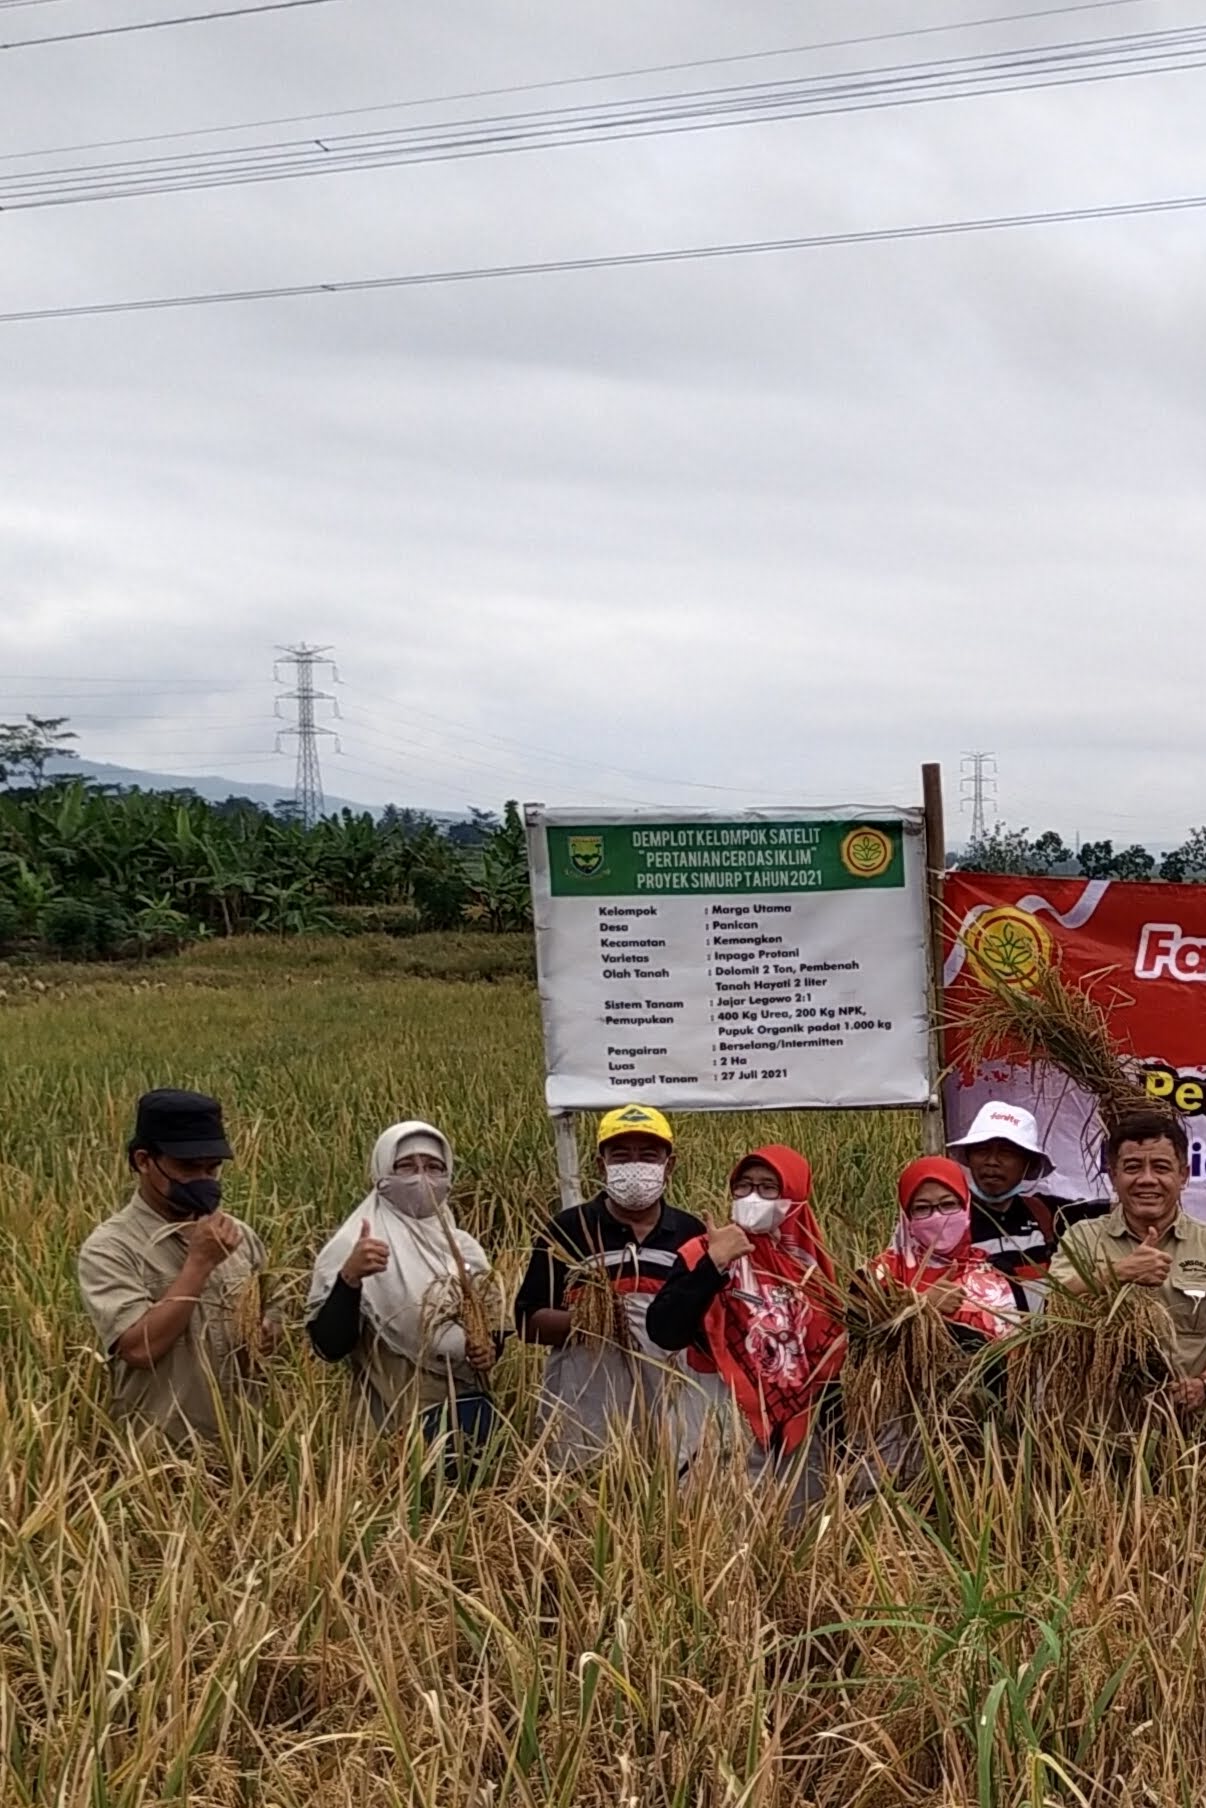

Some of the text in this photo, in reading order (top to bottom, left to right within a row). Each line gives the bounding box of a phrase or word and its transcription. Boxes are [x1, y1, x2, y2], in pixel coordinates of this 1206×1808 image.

[632, 828, 821, 847] DEMPLOT KELOMPOK SATELIT
[722, 849, 773, 867] CERDAS
[637, 869, 822, 889] PROYEK SIMURP TAHUN 2021
[599, 905, 658, 918] Kelompok
[711, 904, 750, 916] Marga
[752, 904, 792, 914] Utama
[599, 922, 629, 932] Desa
[712, 920, 759, 931] Panican
[600, 938, 666, 948] Kecamatan
[713, 934, 783, 946] Kemangkon
[601, 953, 650, 963] Varietas
[714, 951, 755, 962] Inpago
[758, 948, 800, 960] Protani
[602, 968, 632, 979] Olah
[633, 968, 670, 978] Tanah
[715, 965, 760, 976] Dolomit
[762, 965, 770, 974] 2
[772, 964, 797, 975] Ton,
[799, 960, 860, 973] Pembenah
[715, 977, 828, 991] Tanah Hayati 2 liter
[604, 1000, 642, 1010] Sistem
[645, 999, 684, 1009] Tanam
[716, 997, 746, 1008] Jajar
[749, 995, 792, 1007] Legowo
[794, 993, 812, 1003] 2:1
[605, 1014, 674, 1027] Pemupukan
[717, 1011, 739, 1021] 400
[742, 1010, 757, 1022] Kg
[760, 1009, 793, 1020] Urea,
[795, 1008, 817, 1017] 200
[819, 1007, 835, 1019] Kg
[838, 1005, 867, 1016] NPK,
[718, 1020, 892, 1038] Pupuk Organik padat 1.000 kg
[607, 1046, 668, 1057] Pengairan
[719, 1038, 844, 1051] Berselang/Intermitten
[608, 1061, 636, 1071] Luas
[720, 1057, 727, 1066] 2
[730, 1056, 748, 1066] Ha
[609, 1074, 656, 1087] Tanggal
[658, 1074, 698, 1084] Tanam
[721, 1071, 735, 1080] 27
[737, 1069, 758, 1080] Juli
[760, 1069, 788, 1079] 2021
